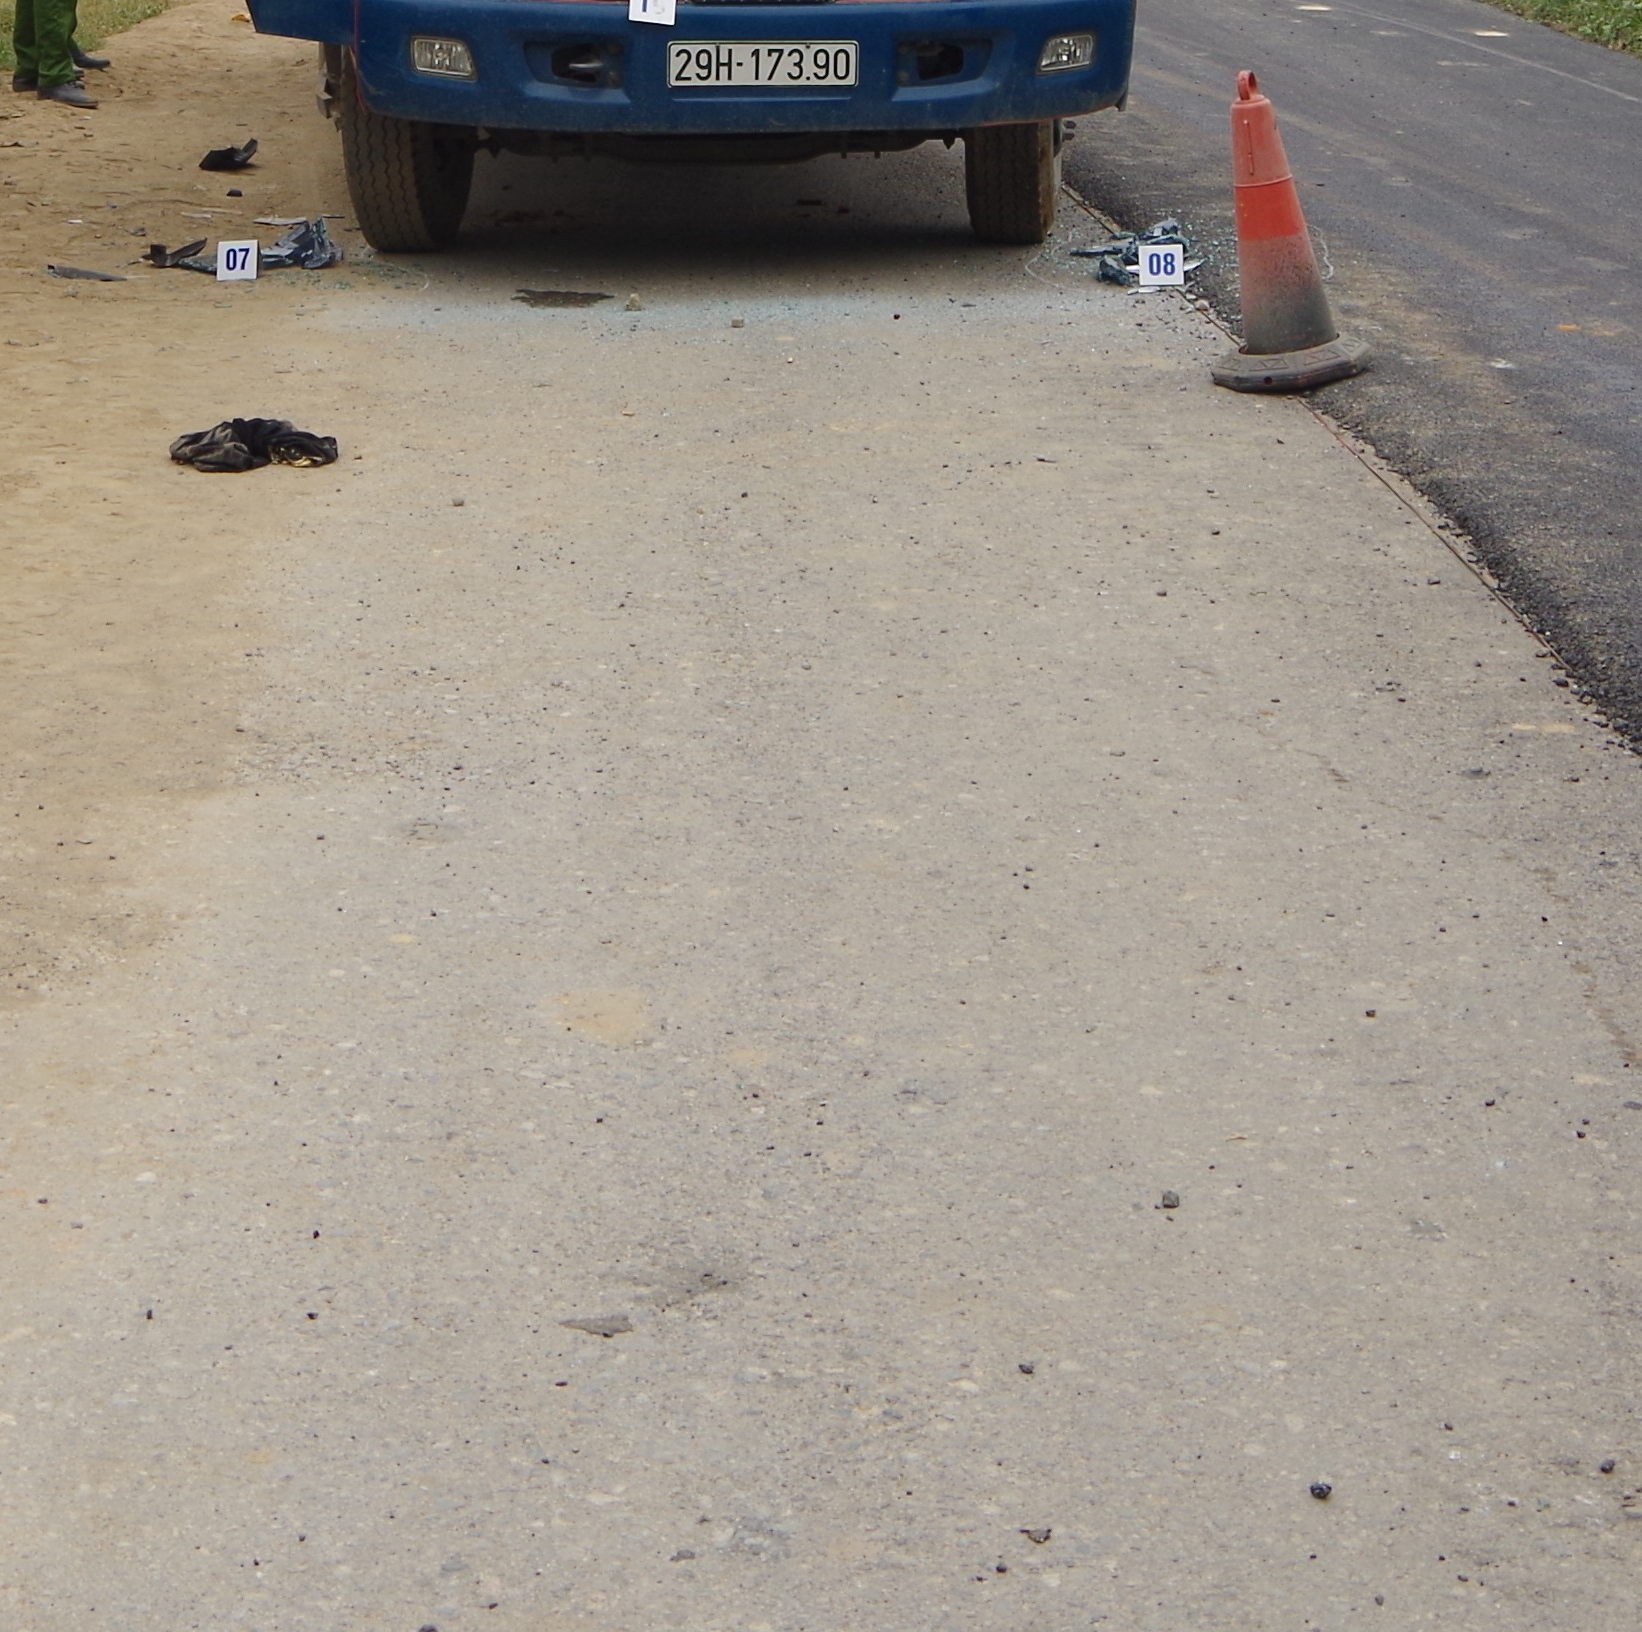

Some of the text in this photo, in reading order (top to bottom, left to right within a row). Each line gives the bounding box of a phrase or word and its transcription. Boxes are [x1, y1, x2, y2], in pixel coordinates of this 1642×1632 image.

[675, 45, 850, 82] 29H-173.90
[226, 247, 250, 271] 07
[1148, 252, 1175, 277] 08
